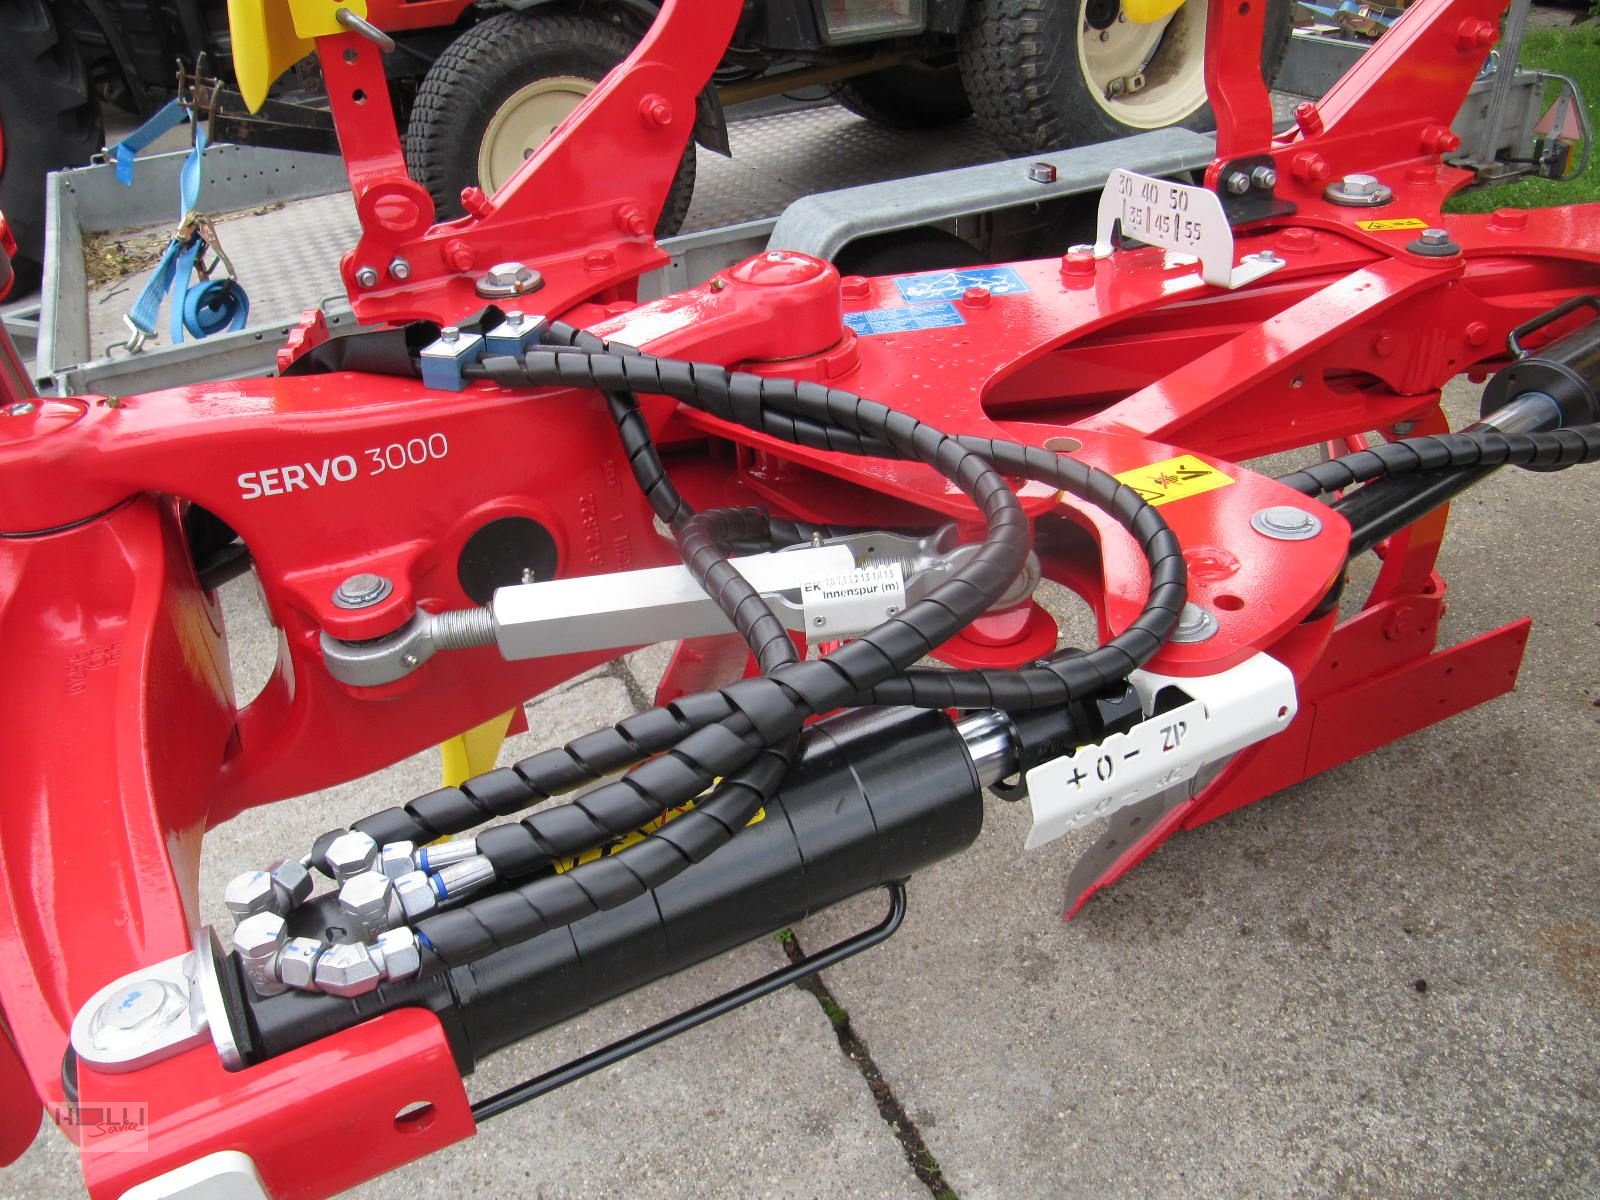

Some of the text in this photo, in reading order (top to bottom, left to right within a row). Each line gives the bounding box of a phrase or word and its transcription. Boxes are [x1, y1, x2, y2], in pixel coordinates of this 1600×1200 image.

[1118, 174, 1189, 212] 30 40 50
[1129, 206, 1201, 241] 35 45 55
[237, 432, 448, 500] SERVO 3000
[823, 581, 900, 600] Innenspur (m)
[1159, 721, 1188, 752] ZP
